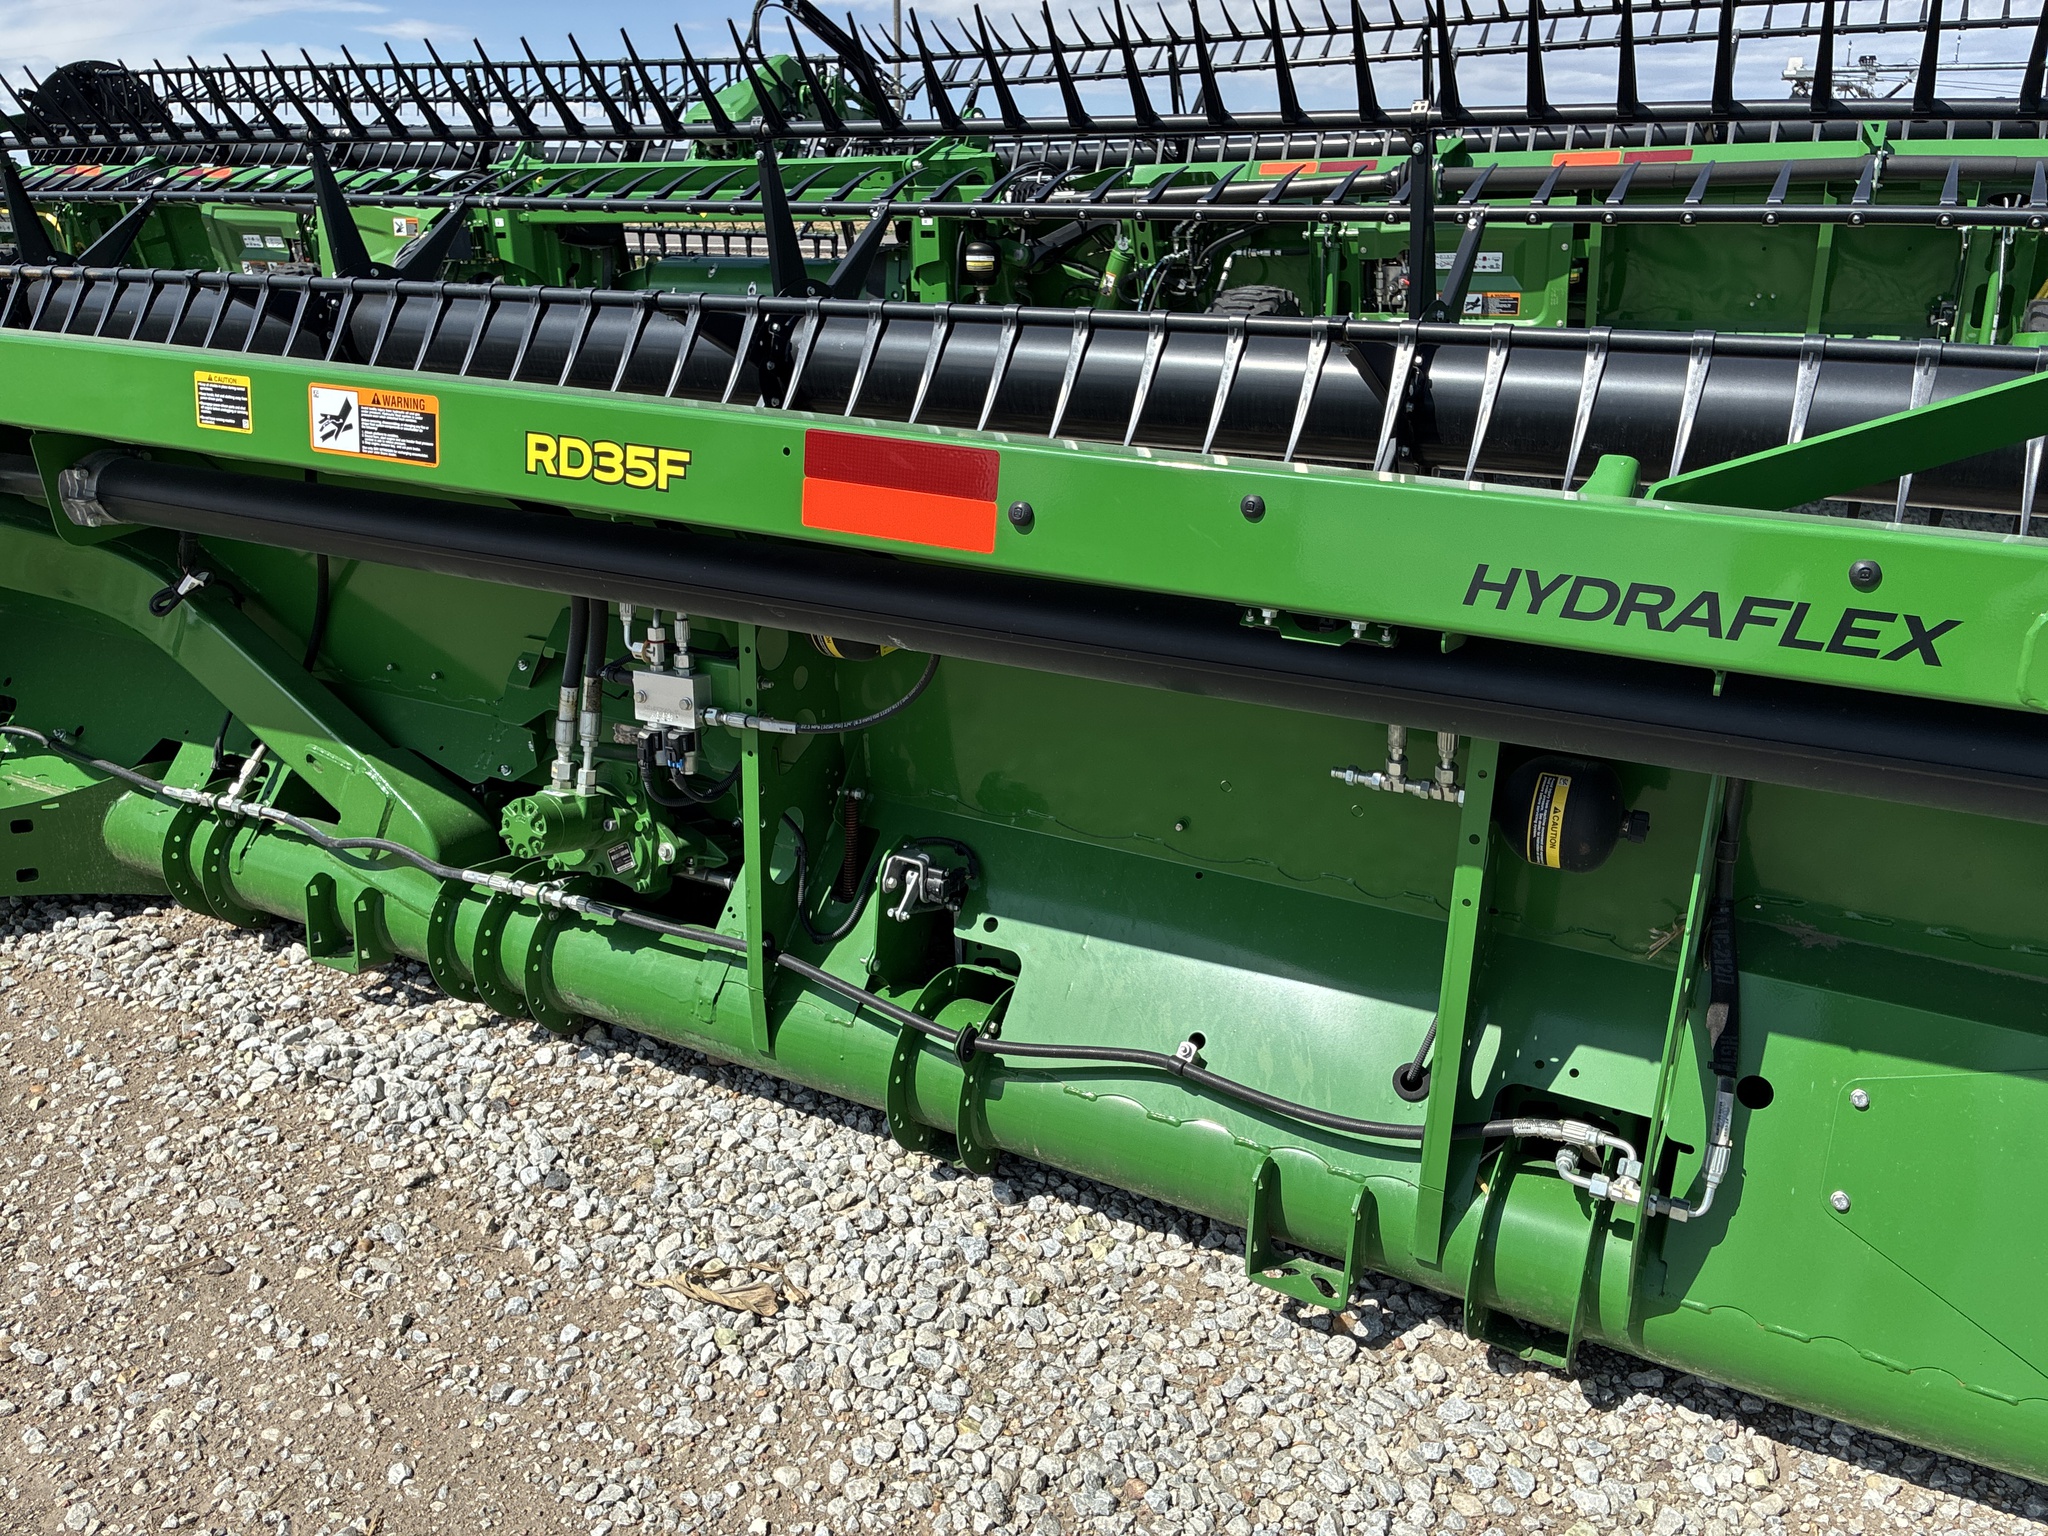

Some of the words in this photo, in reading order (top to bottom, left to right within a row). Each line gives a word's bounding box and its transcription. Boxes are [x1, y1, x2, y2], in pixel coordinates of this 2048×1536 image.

[213, 375, 237, 384] CAUTION
[382, 394, 425, 411] WARNING
[525, 431, 692, 493] RD35F
[1462, 564, 1964, 667] HYDRAFLEX
[1549, 815, 1559, 849] CAUTION
